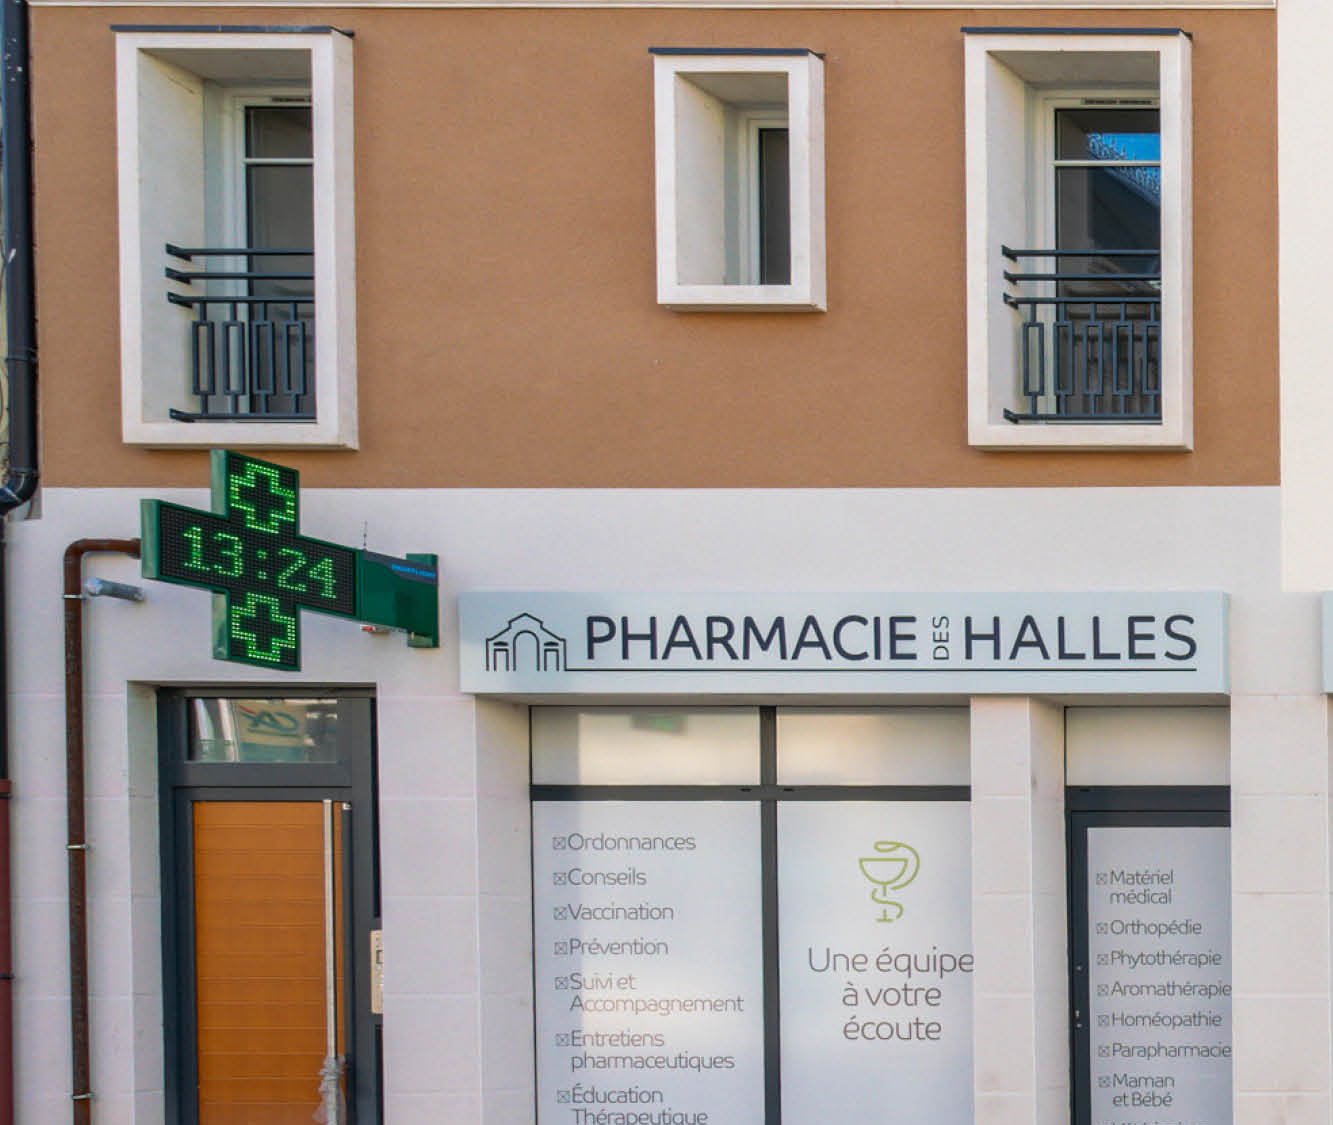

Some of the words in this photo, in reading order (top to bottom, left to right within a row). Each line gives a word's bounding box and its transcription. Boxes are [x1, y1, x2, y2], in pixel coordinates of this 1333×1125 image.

[182, 526, 337, 599] 13:24
[586, 615, 917, 660] PHARMACIE
[932, 615, 949, 660] DES
[964, 615, 1197, 661] HALLES
[567, 833, 697, 850] Ordonnances
[567, 867, 647, 885] Conseils
[1110, 868, 1174, 885] Matériel
[1110, 888, 1172, 904] médical
[567, 902, 674, 920] Vaccination
[1110, 919, 1202, 938] Orthopédie
[569, 937, 669, 955] Prévention
[808, 947, 868, 972] Une
[875, 946, 974, 979] équipe
[1111, 949, 1222, 969] Phytothérapie
[569, 972, 613, 990] Suivi
[616, 974, 636, 990] et
[1111, 980, 1232, 998] Aromathérapie
[842, 981, 858, 1006] à
[865, 982, 942, 1006] votre
[569, 995, 744, 1016] Accompagnement
[843, 1015, 942, 1040] écoute
[1112, 1010, 1222, 1029] Homéopathie
[571, 1028, 665, 1046] Entretiens
[1112, 1041, 1232, 1060] Parapharmacie
[571, 1051, 735, 1072] pharmaceutiques
[1112, 1072, 1175, 1088] Maman
[571, 1083, 664, 1103] Éducation
[1112, 1093, 1128, 1107] et
[1132, 1091, 1173, 1107] Bébé
